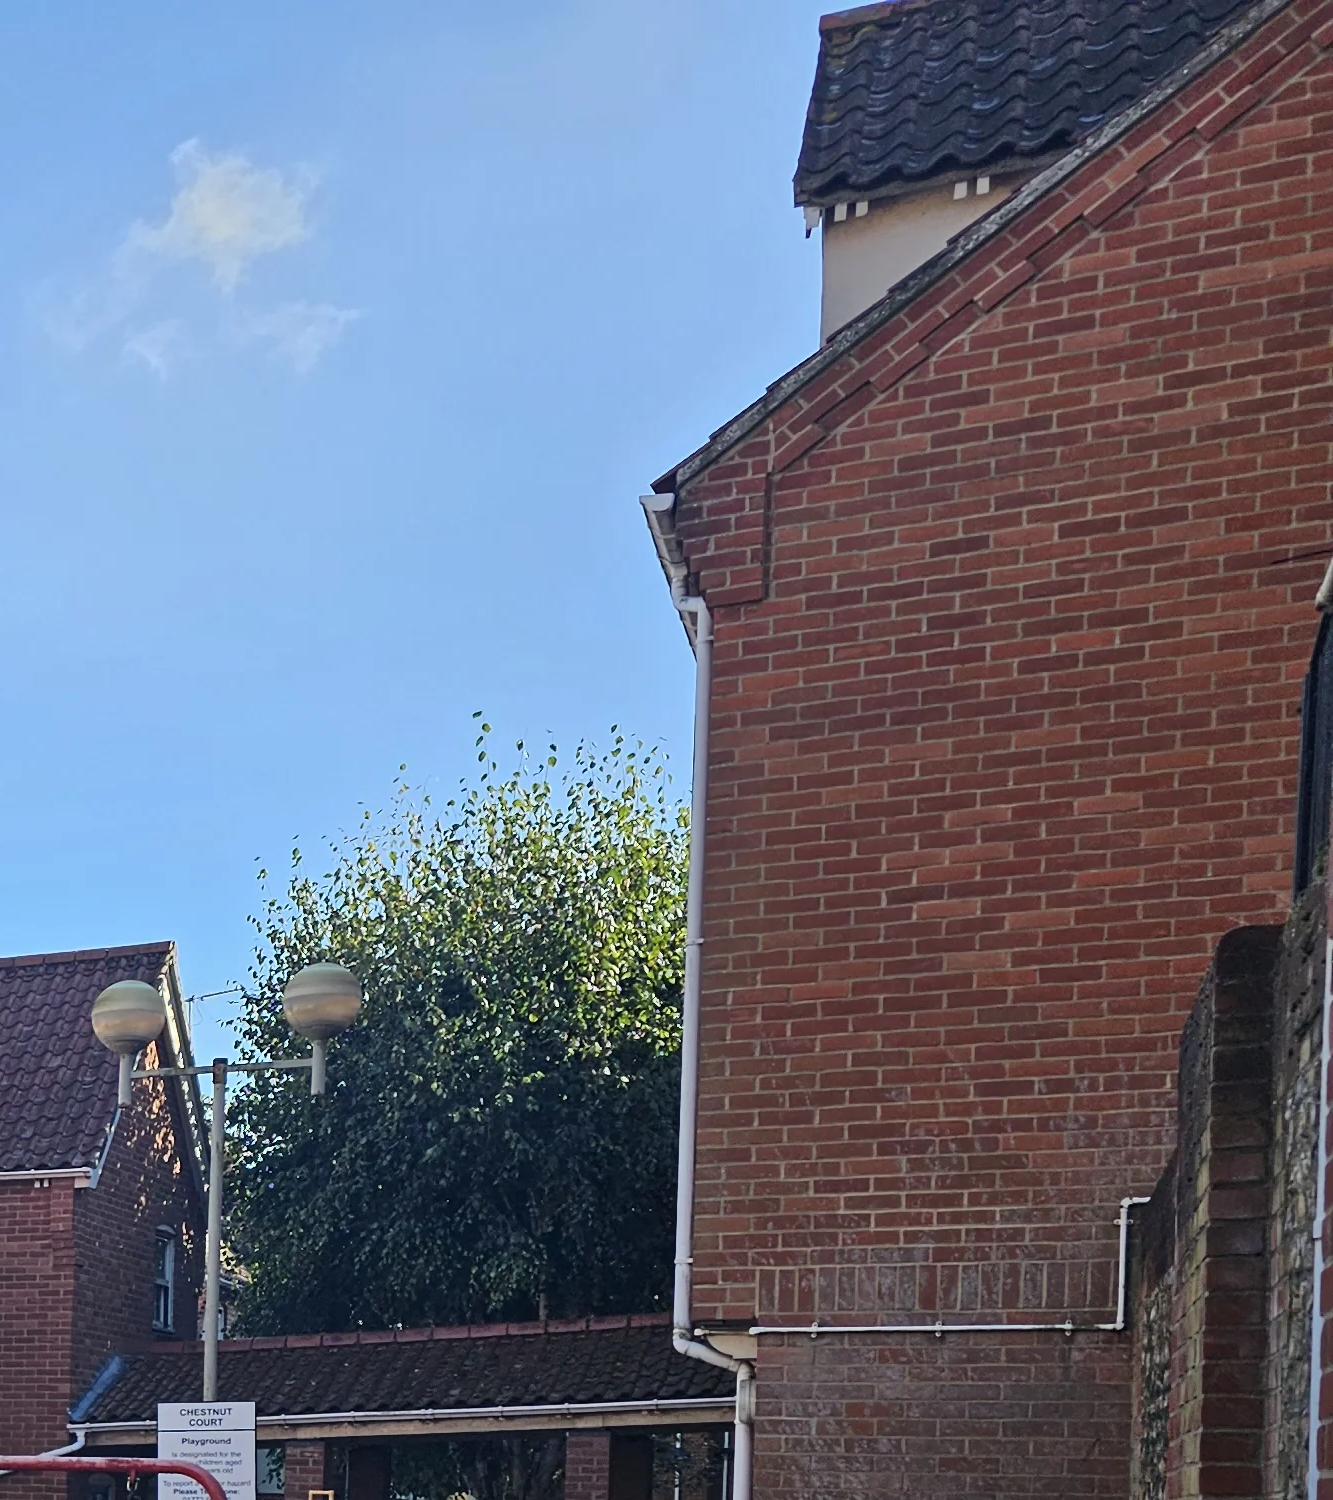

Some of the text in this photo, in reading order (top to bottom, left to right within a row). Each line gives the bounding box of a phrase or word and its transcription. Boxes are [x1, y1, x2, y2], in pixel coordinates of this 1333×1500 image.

[179, 1407, 233, 1417] CHESTNUT
[189, 1418, 223, 1427] COURT
[181, 1437, 232, 1446] Playground
[179, 1451, 218, 1459] designated
[224, 1459, 243, 1467] aged
[173, 1480, 193, 1488] report
